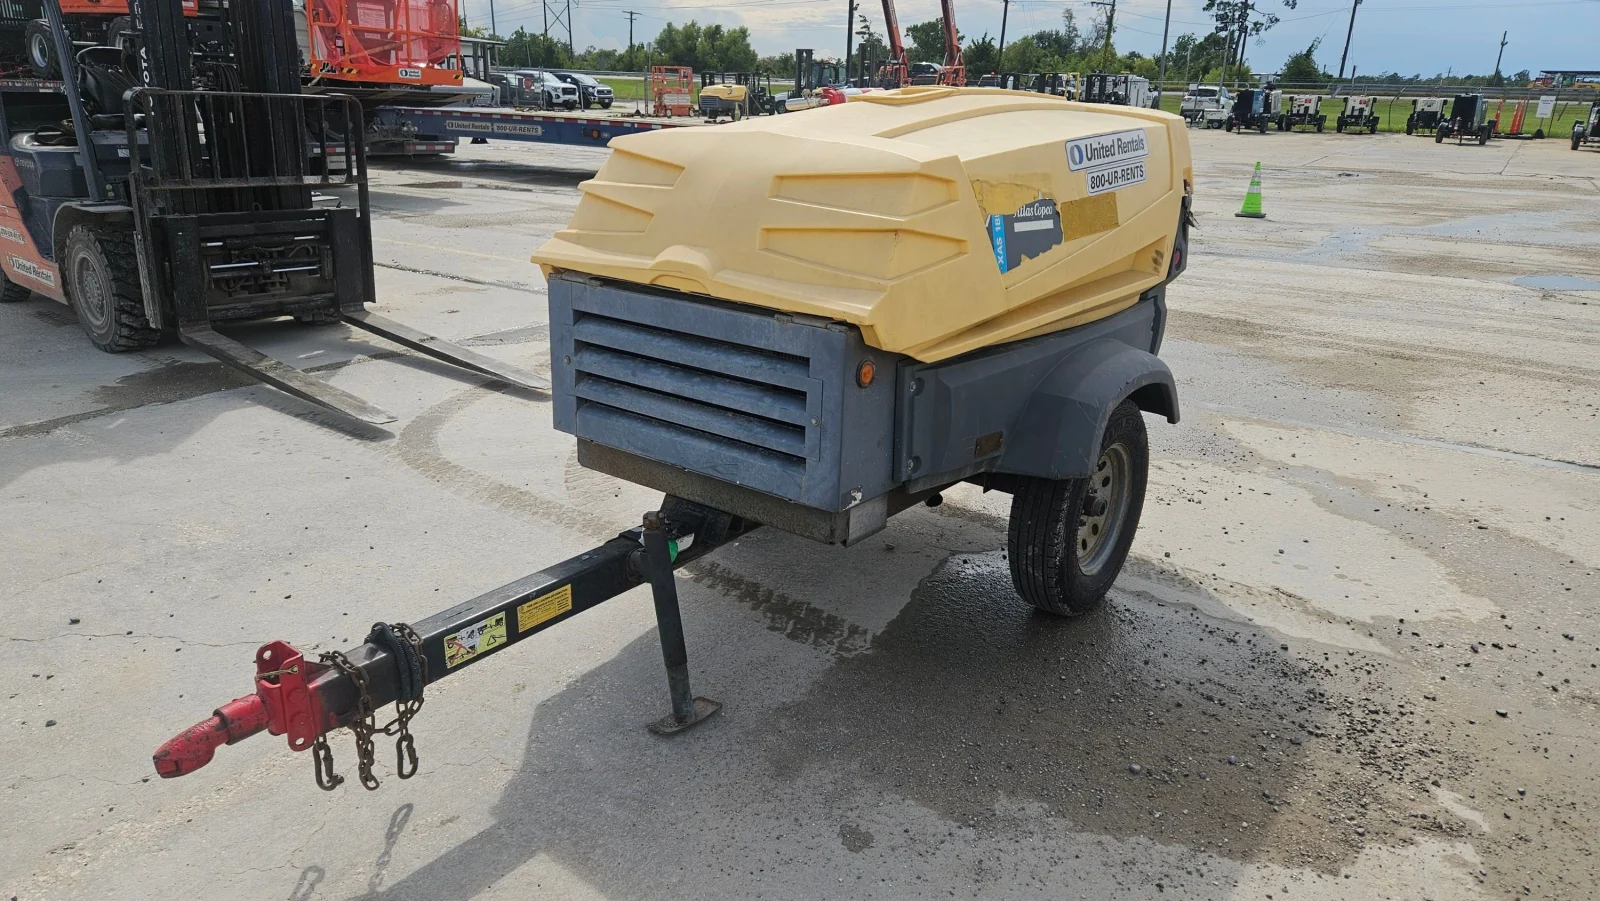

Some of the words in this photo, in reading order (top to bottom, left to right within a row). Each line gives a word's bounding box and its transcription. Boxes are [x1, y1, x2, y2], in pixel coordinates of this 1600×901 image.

[1085, 139, 1115, 161] United
[1117, 134, 1144, 155] Rentals
[1091, 165, 1144, 190] 800-UR-RENTS
[1034, 203, 1053, 218] Copco
[15, 258, 32, 275] United
[32, 266, 52, 280] Rentals
